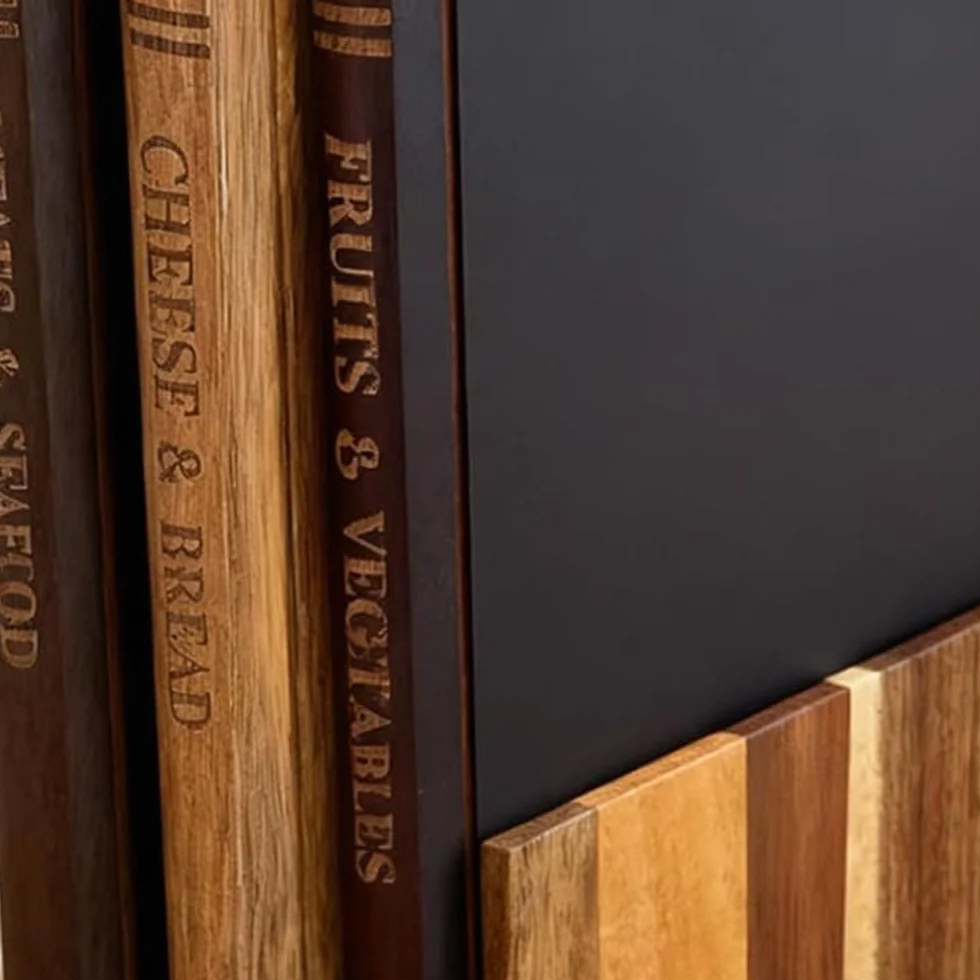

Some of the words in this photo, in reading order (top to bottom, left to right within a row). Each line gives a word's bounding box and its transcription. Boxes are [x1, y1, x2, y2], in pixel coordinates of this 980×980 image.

[140, 134, 200, 417] CHEESE
[324, 133, 381, 396] FRUITS
[157, 440, 202, 482] &
[335, 428, 380, 480] &
[160, 520, 212, 732] BREAD
